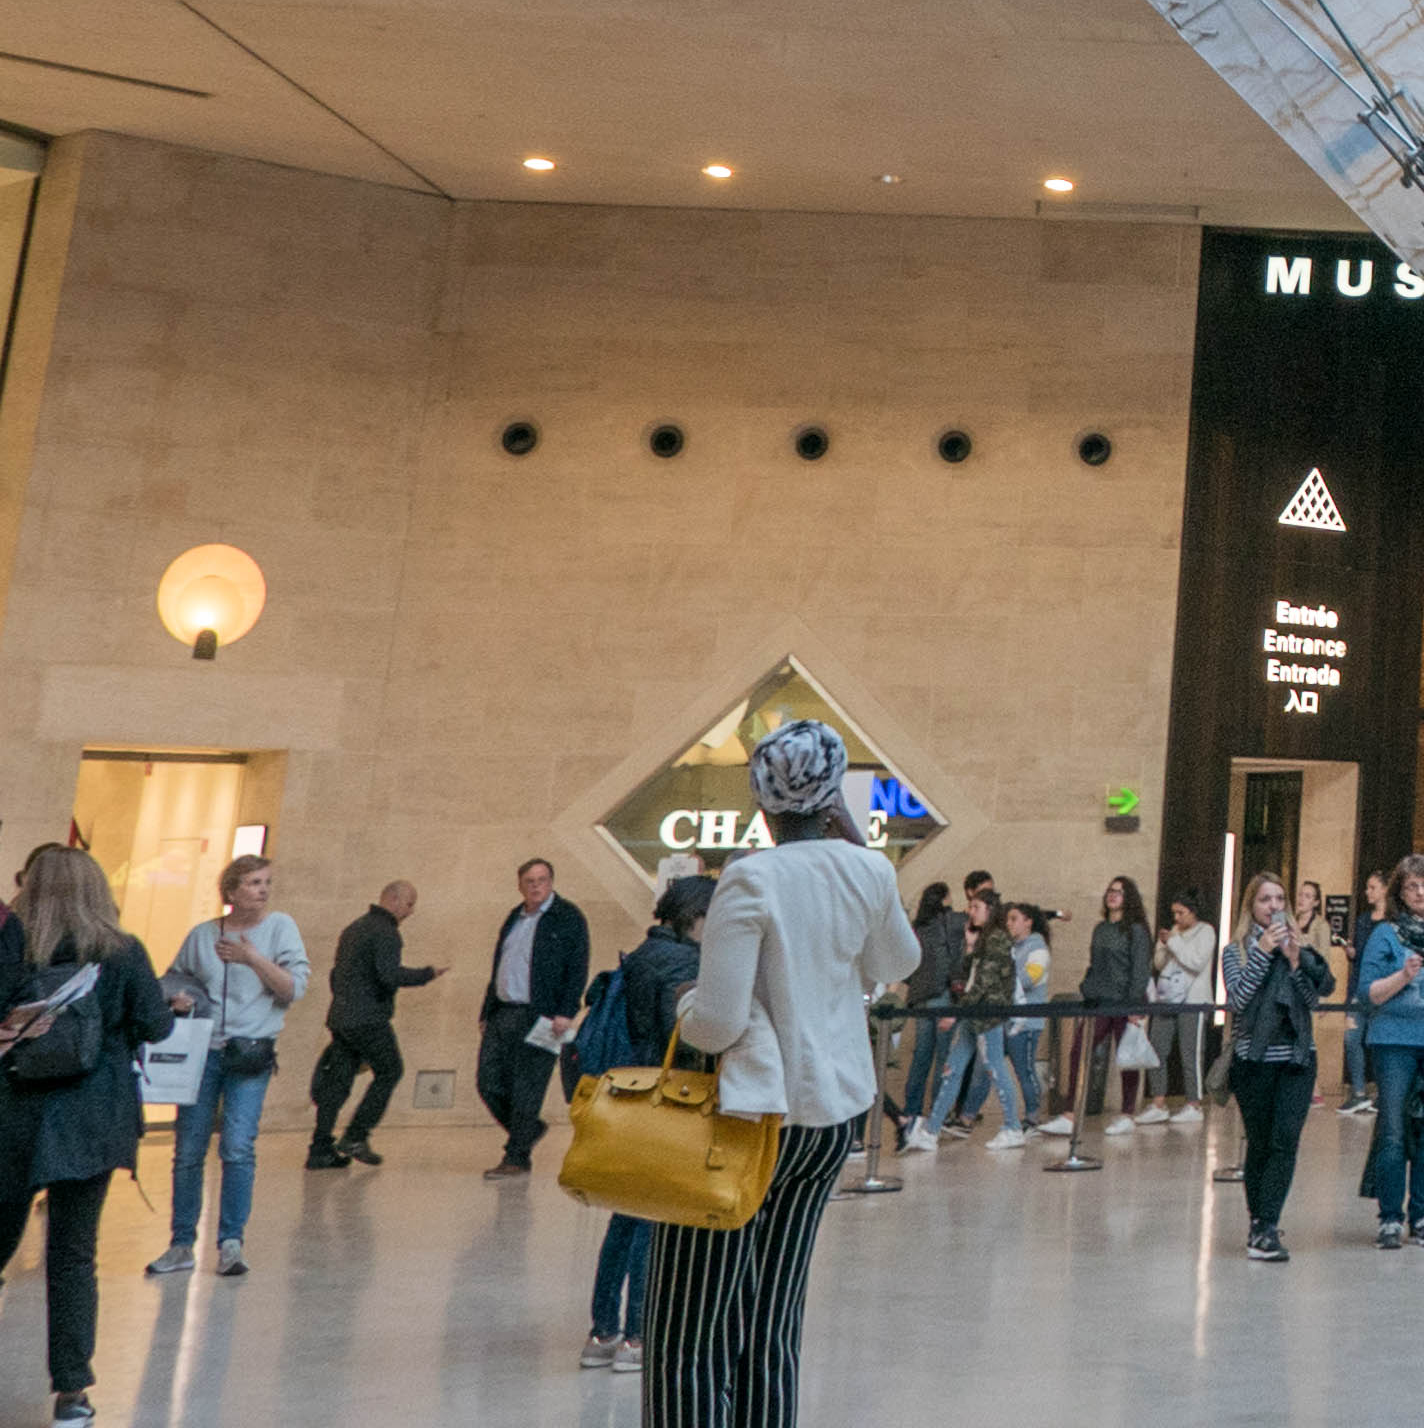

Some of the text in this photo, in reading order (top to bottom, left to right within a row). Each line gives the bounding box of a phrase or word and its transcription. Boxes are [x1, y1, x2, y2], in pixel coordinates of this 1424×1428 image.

[1276, 600, 1339, 628] Entrée
[1263, 628, 1347, 658] Entrance
[1267, 658, 1341, 686] Entrada
[1284, 689, 1319, 714] 入口
[659, 809, 889, 850] CHAE
